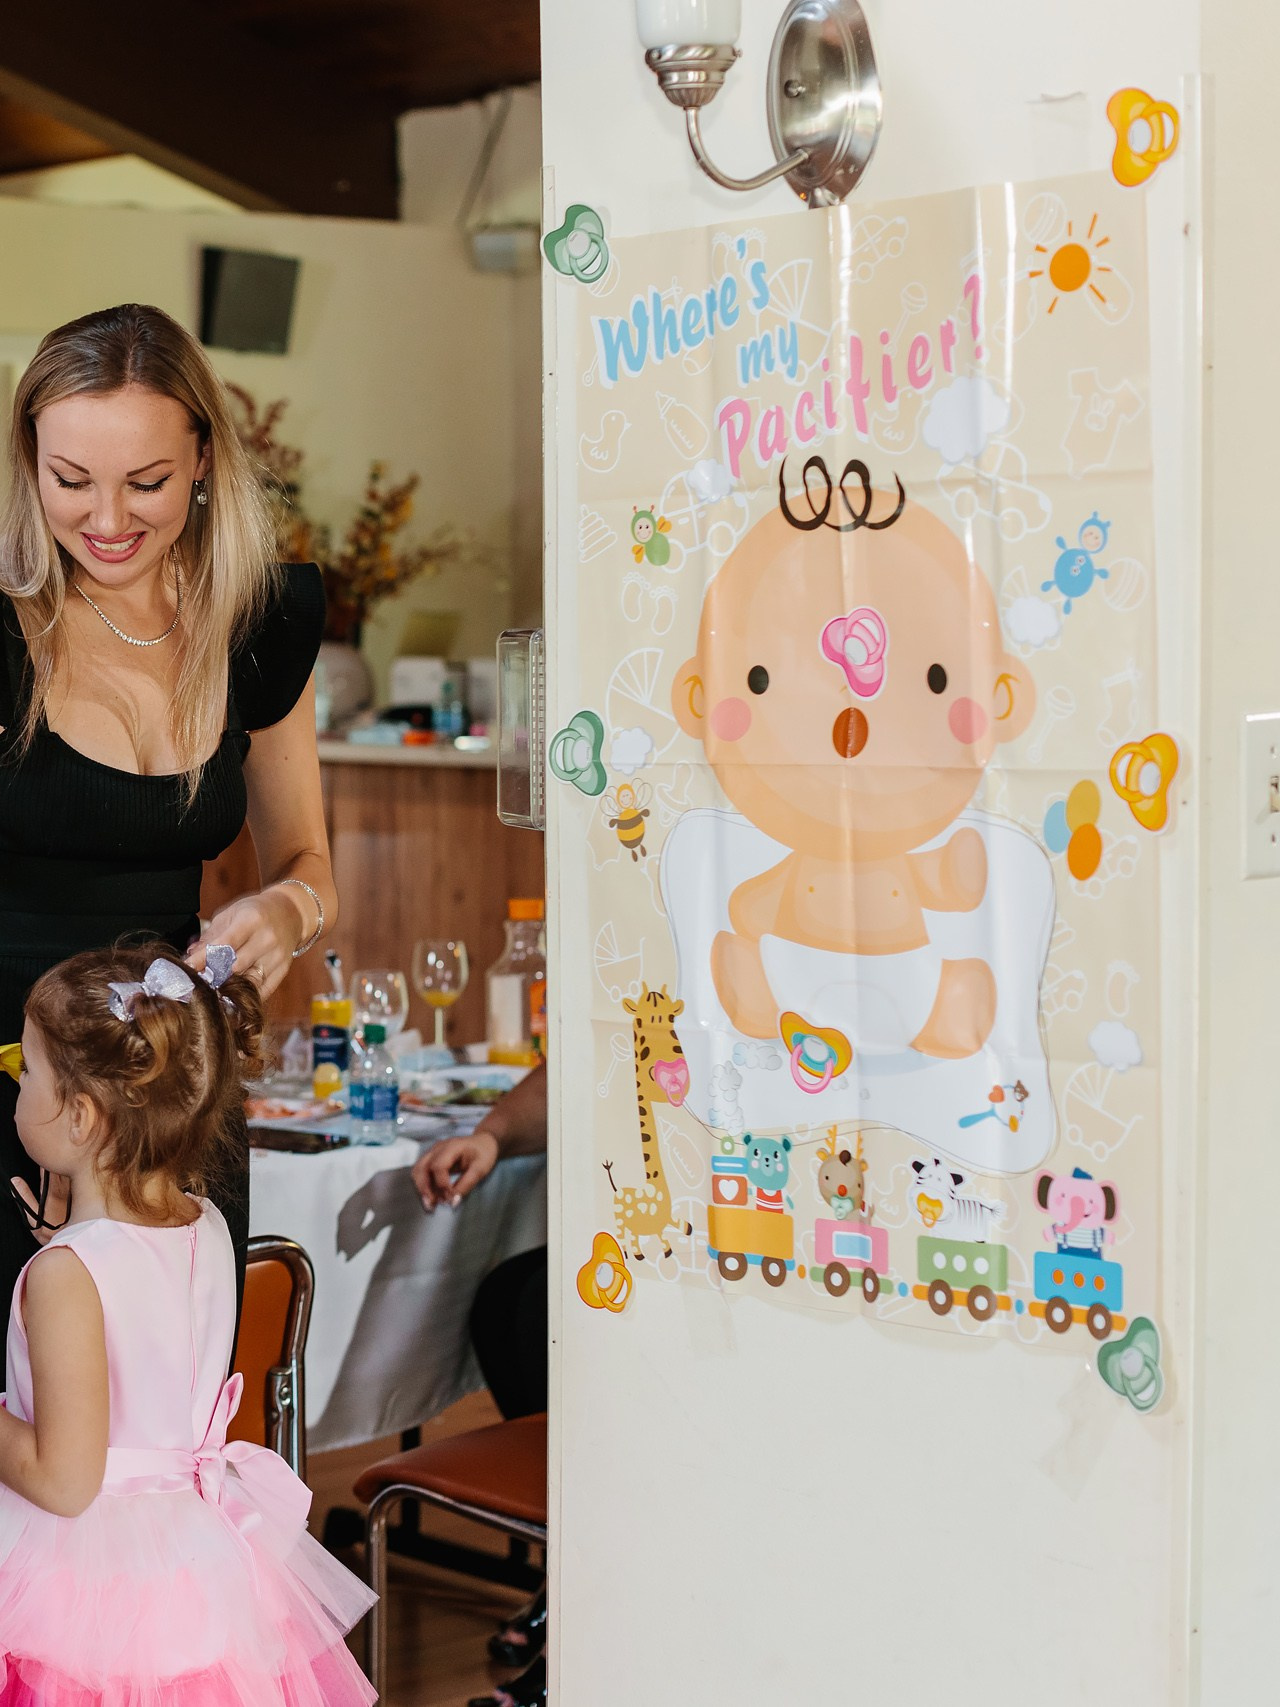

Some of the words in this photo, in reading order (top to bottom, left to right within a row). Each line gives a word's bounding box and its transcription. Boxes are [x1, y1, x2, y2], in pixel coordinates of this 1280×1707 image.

[598, 237, 770, 382] Where's
[719, 273, 983, 479] Pacifier?
[740, 320, 798, 384] my
